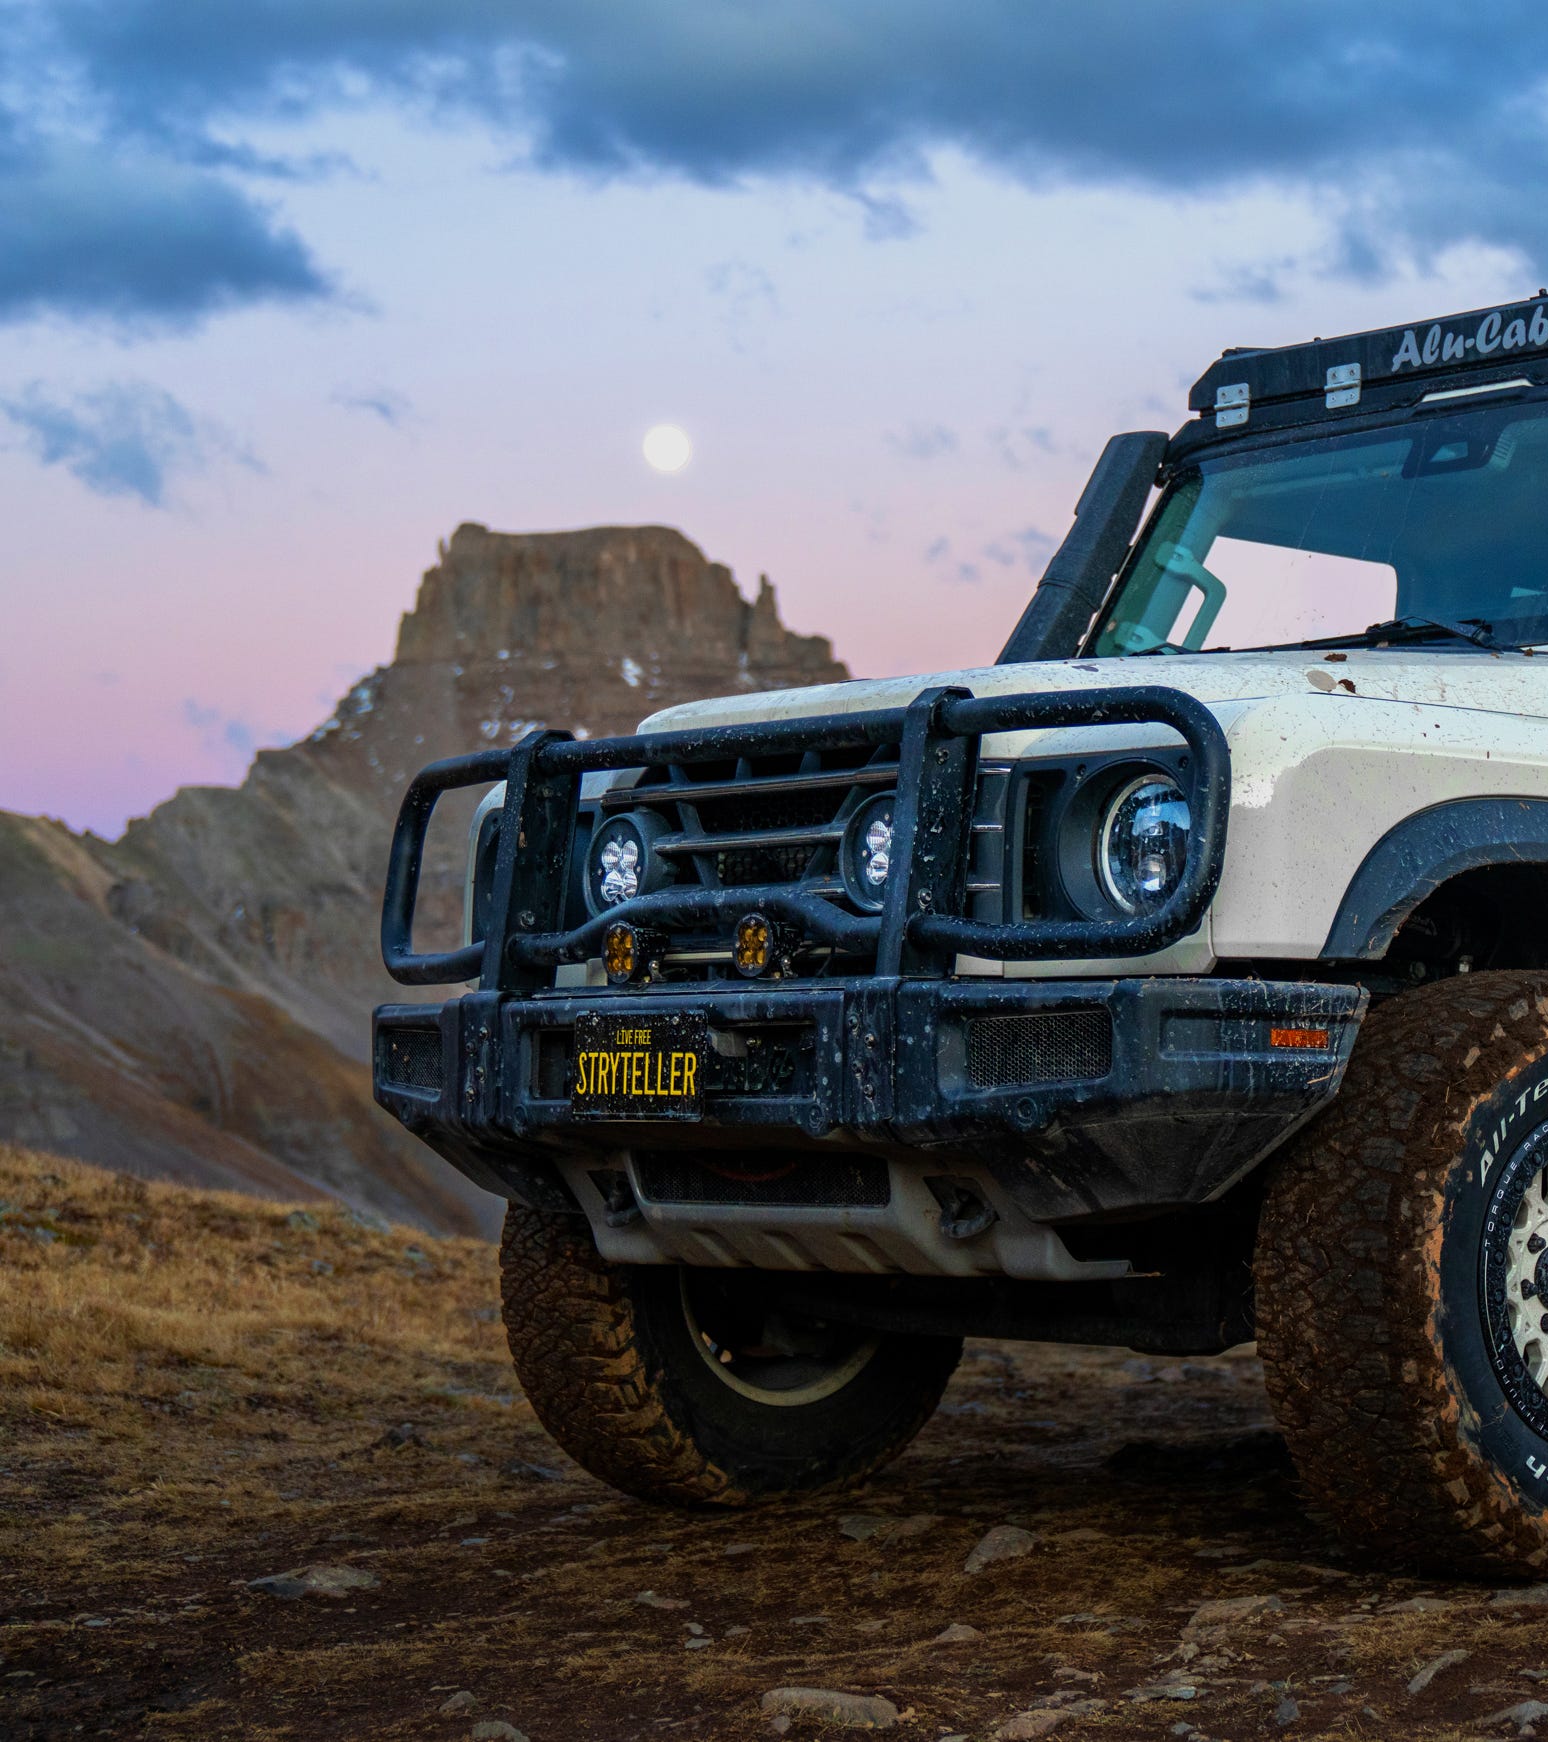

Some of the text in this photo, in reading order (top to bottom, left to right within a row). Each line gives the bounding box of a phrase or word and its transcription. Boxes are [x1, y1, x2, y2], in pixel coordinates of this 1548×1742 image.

[616, 1029, 652, 1045] LIVE FREE
[576, 1052, 697, 1096] STRYTELLER
[1484, 1161, 1518, 1248] TORQUE
